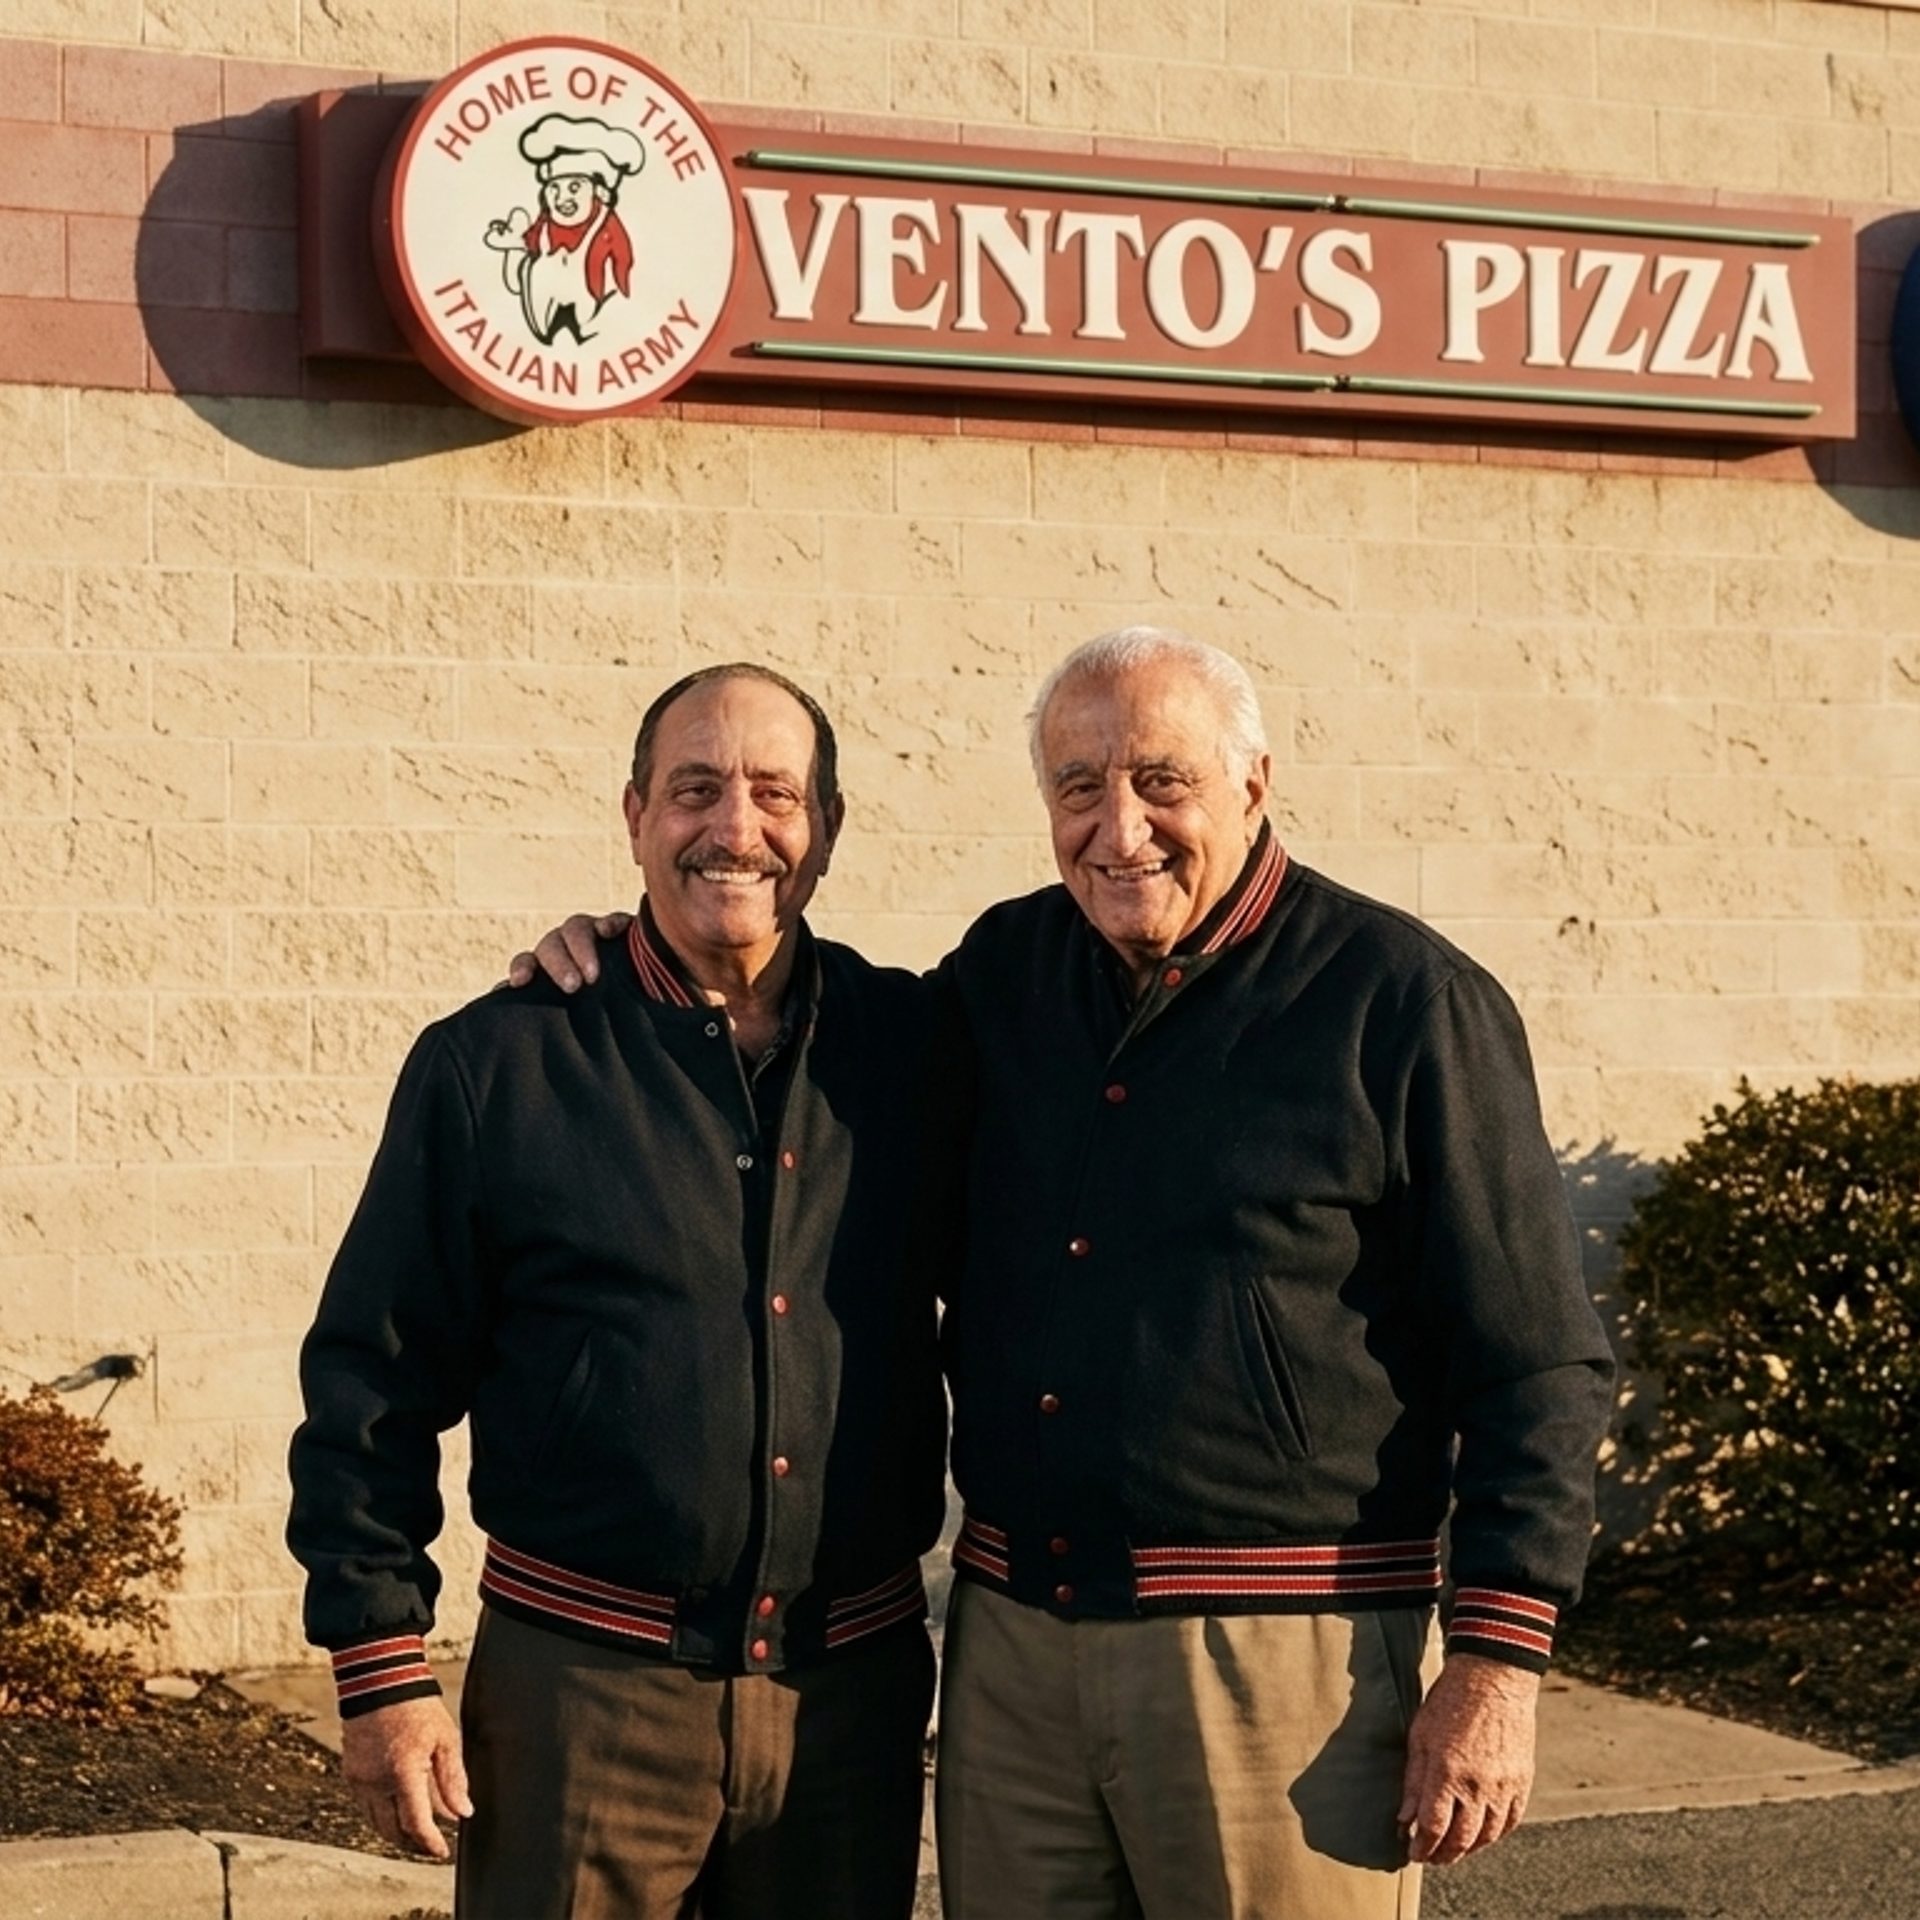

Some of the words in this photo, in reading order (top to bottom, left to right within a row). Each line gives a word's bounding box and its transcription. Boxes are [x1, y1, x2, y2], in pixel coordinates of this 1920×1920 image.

[434, 66, 552, 162] HOME
[567, 66, 628, 106] OF
[637, 97, 706, 182] THE
[434, 279, 578, 396] ITALIAN
[597, 299, 700, 395] ARMY
[743, 188, 1382, 357] VENTO'S
[1441, 239, 1813, 383] PIZZA
